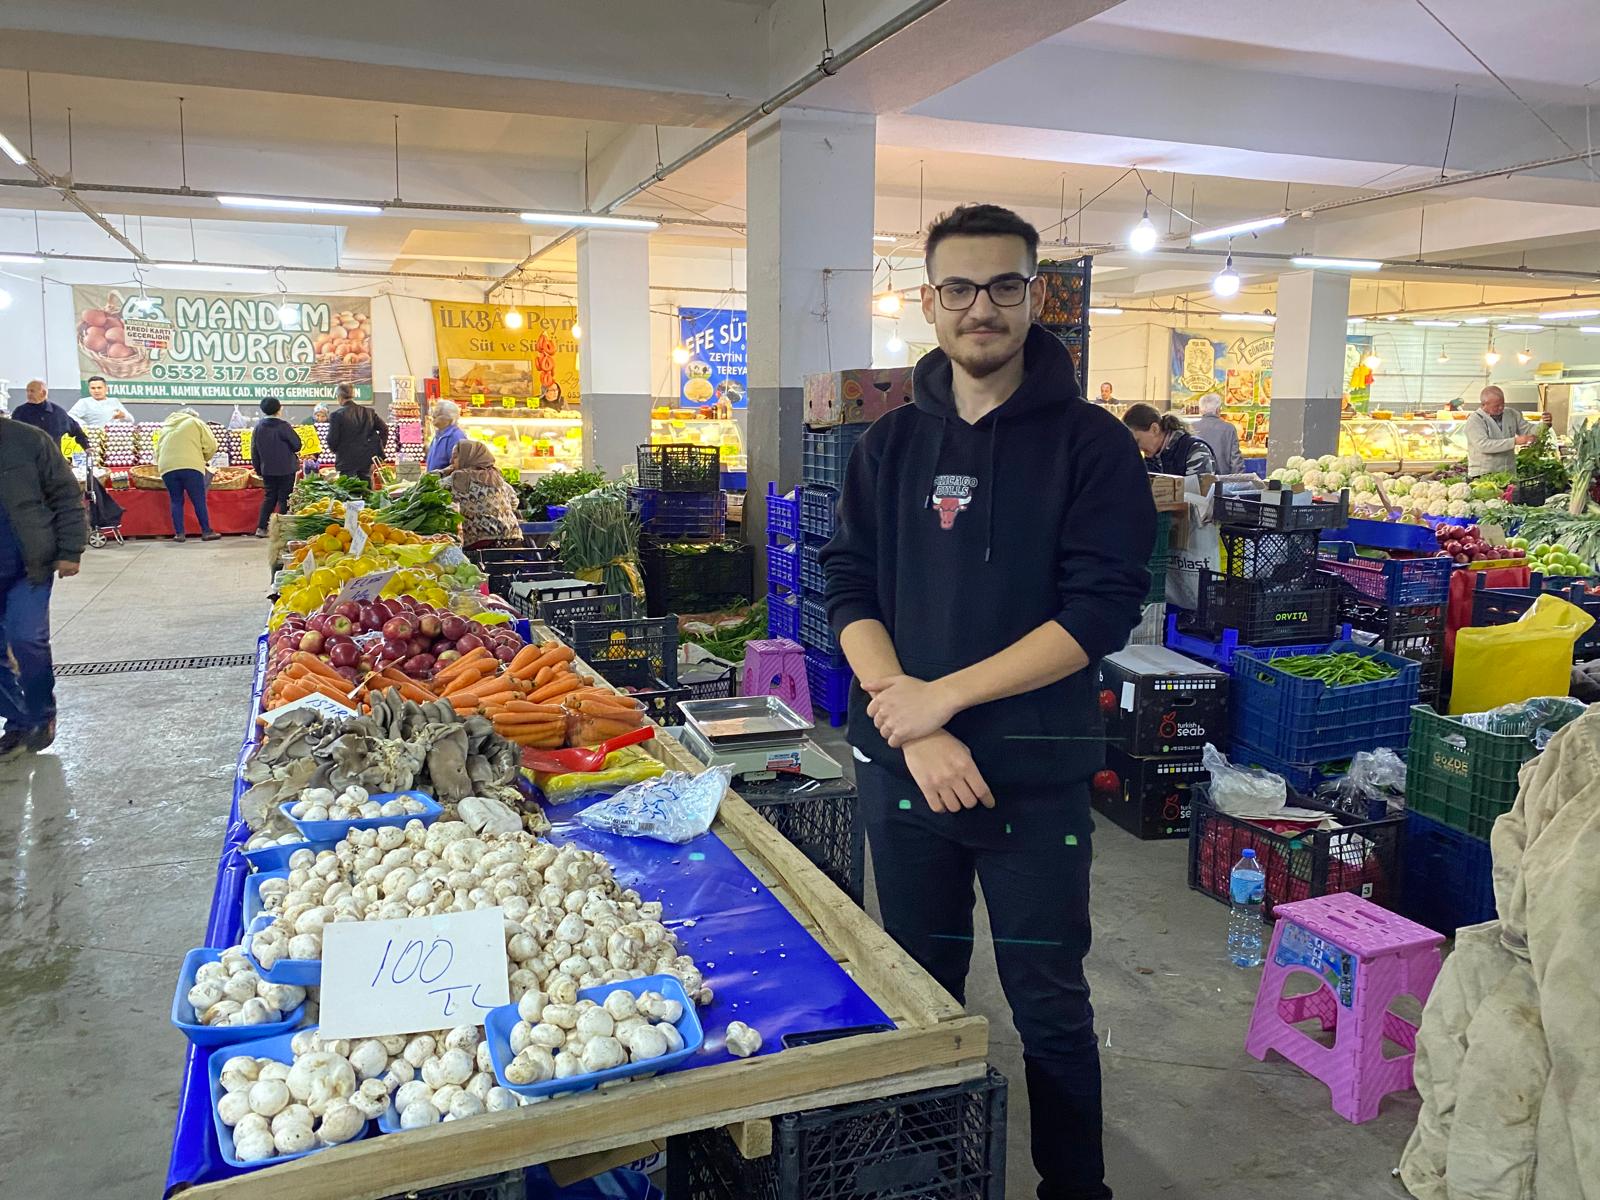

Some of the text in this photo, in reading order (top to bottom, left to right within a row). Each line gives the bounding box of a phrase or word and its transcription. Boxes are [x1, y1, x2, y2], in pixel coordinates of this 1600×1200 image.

[470, 338, 495, 352] Süt
[501, 341, 516, 352] ve
[686, 329, 714, 358] EFE
[709, 351, 743, 363] ZEYTİN
[151, 365, 311, 382] 0532 317 68 07
[106, 384, 143, 396] TAKLAR
[145, 385, 170, 396] MAH.
[171, 385, 201, 397] NAMIK
[202, 386, 232, 397] KEMAL
[233, 386, 254, 398] CAD.
[255, 386, 285, 398] NO:103
[935, 485, 970, 496] BULLS
[1275, 611, 1308, 621] ORVITA
[1177, 725, 1206, 737] seab
[1180, 808, 1192, 819] se
[1363, 886, 1371, 895] 3
[371, 937, 454, 988] 100
[427, 983, 498, 1017] TL
